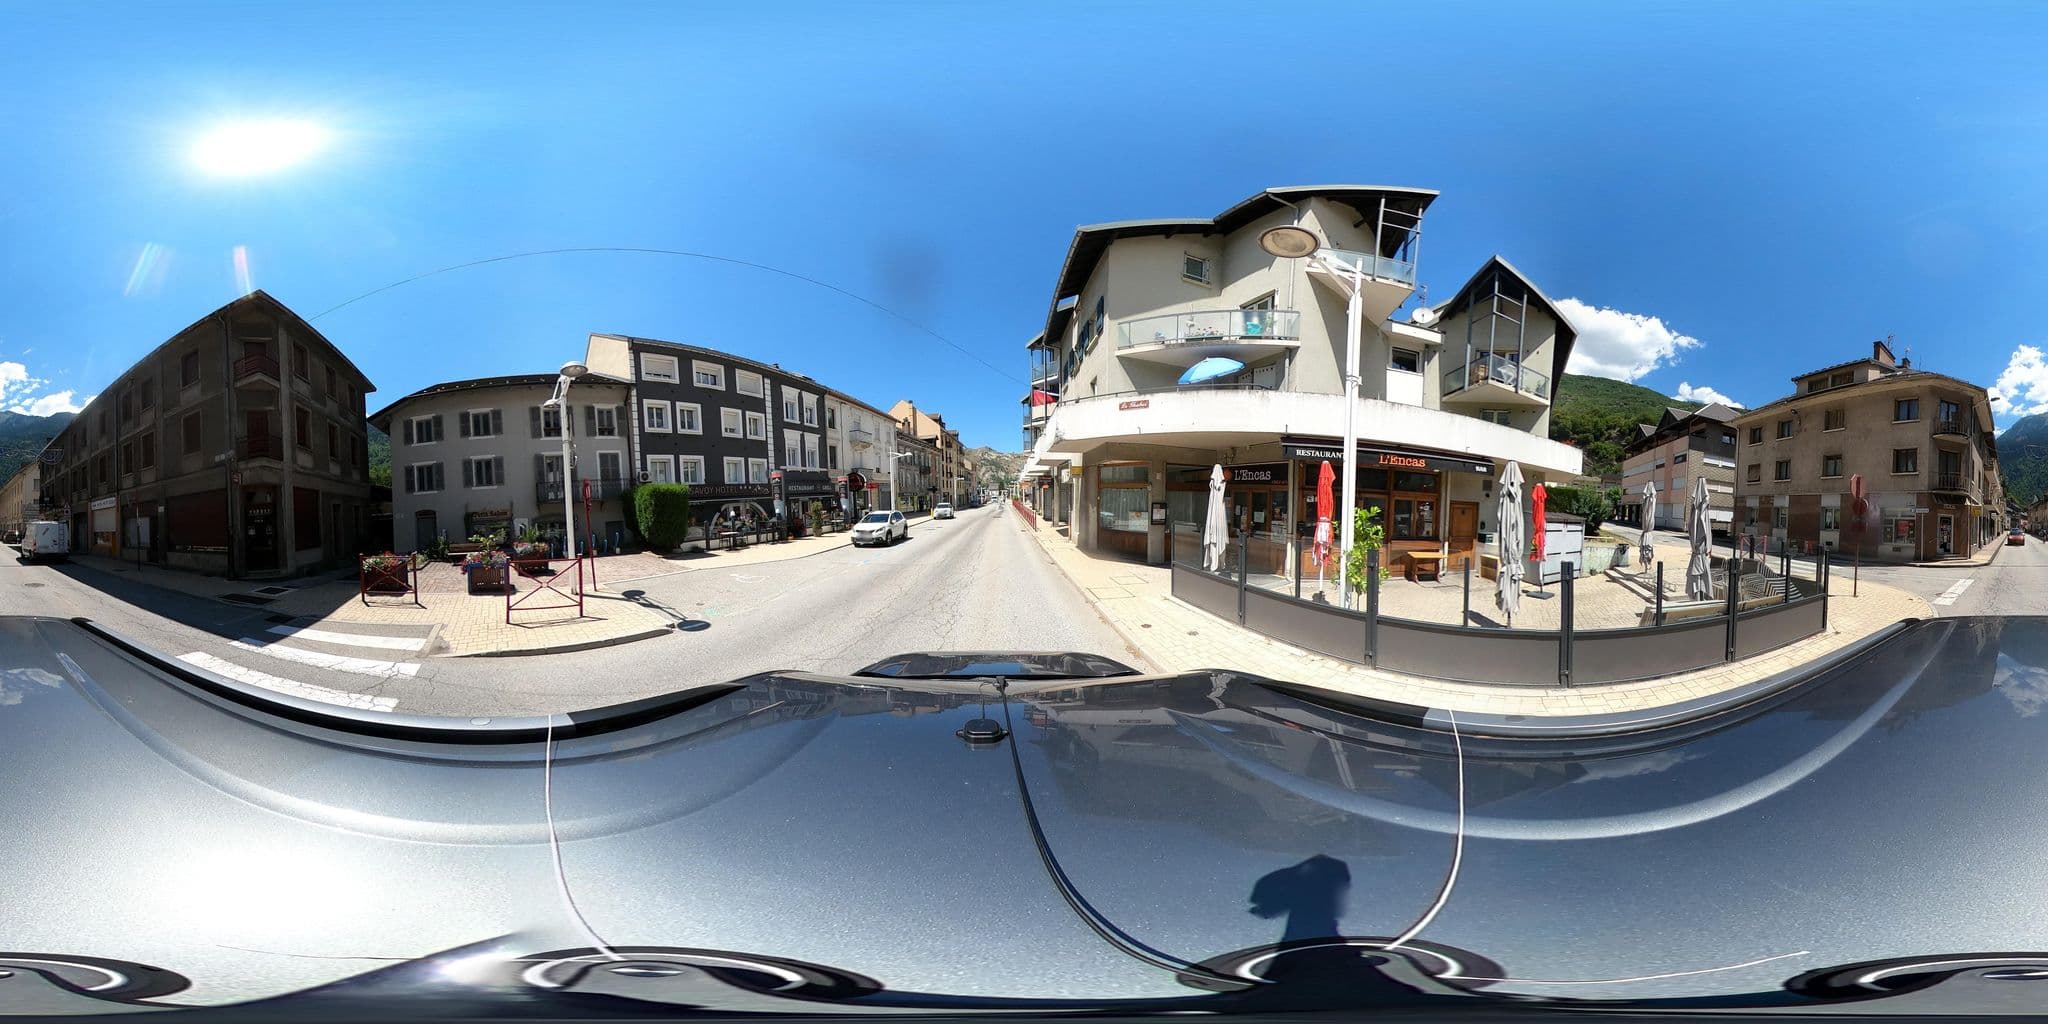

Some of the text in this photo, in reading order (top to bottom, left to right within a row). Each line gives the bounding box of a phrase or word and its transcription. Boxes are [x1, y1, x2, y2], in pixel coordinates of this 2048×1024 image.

[1379, 454, 1426, 468] L'Encas
[1234, 469, 1272, 481] L'Encas
[688, 486, 714, 496] SAVOY
